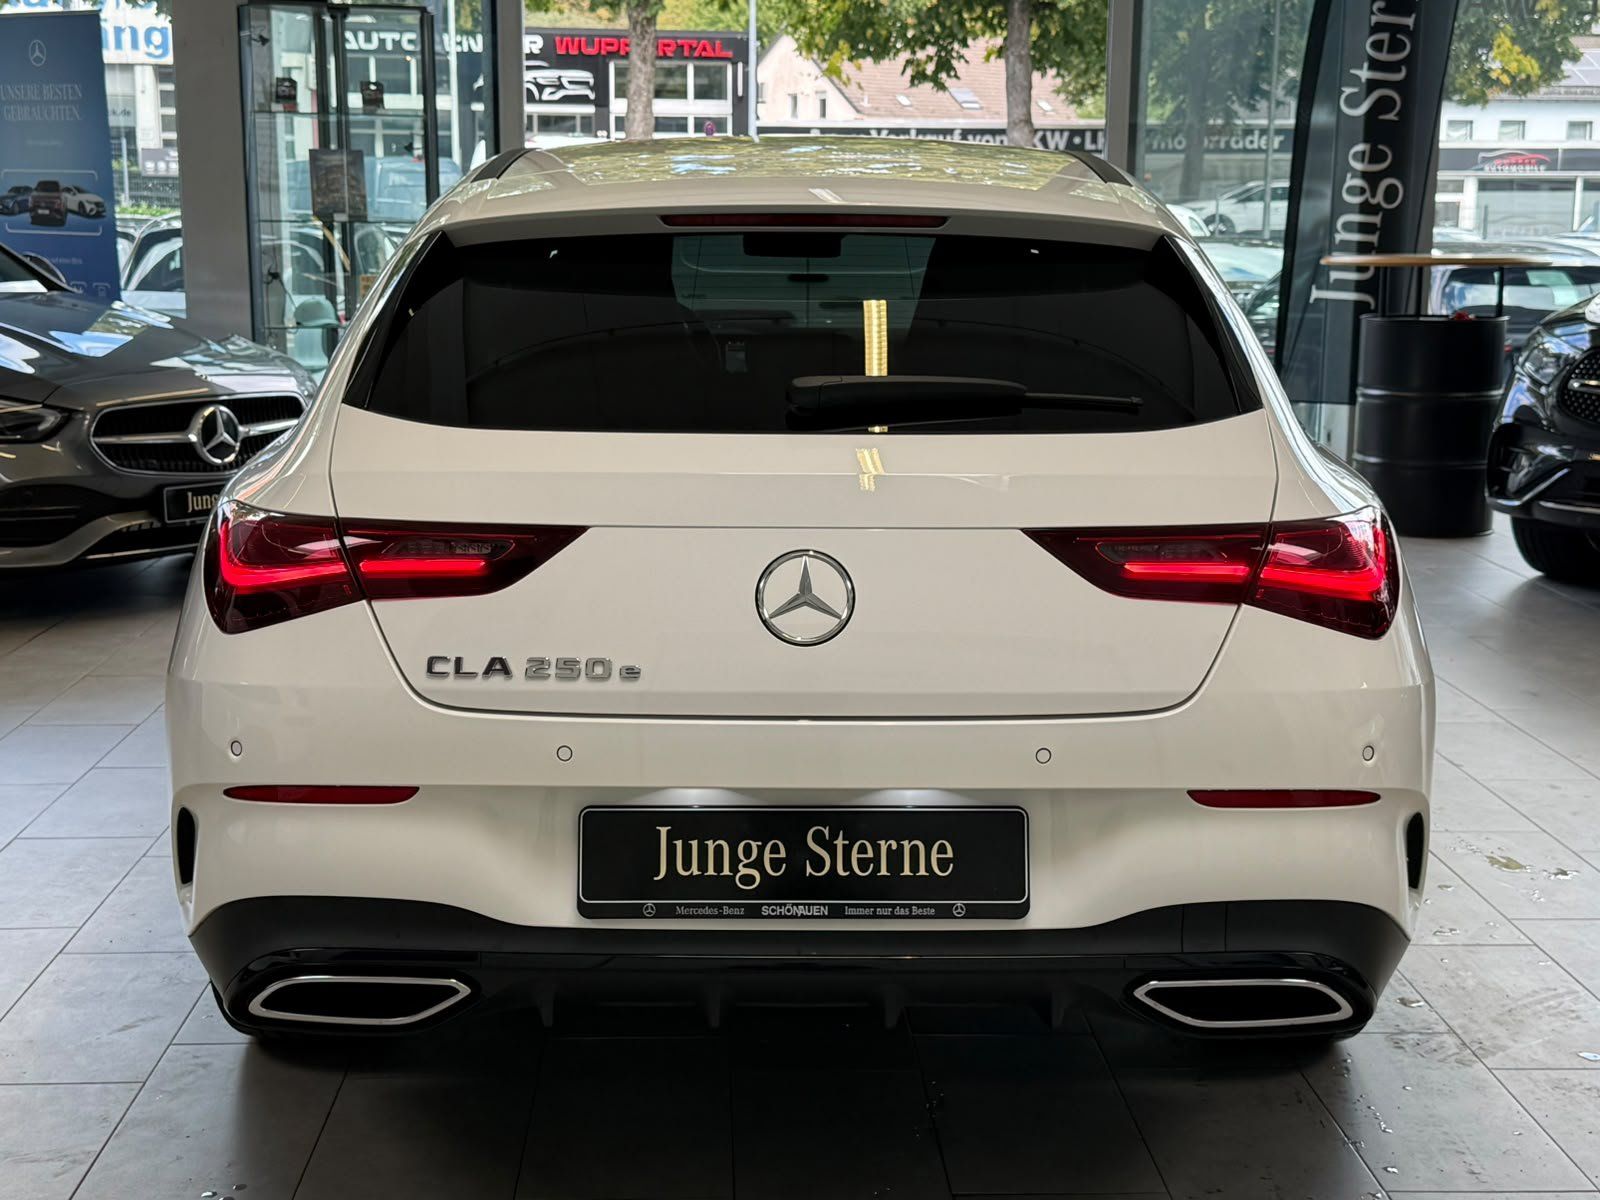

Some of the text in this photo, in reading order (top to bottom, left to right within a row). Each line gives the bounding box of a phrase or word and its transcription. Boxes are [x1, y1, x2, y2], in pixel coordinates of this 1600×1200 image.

[555, 36, 733, 58] WUPPRTAL
[1309, 0, 1418, 310] Junge Ster
[426, 655, 642, 681] CLA 250 e
[653, 825, 954, 891] Junge Sterne
[675, 903, 936, 917] Mercedes-Benz SCHÖNAUEN Immer nur das Beste
